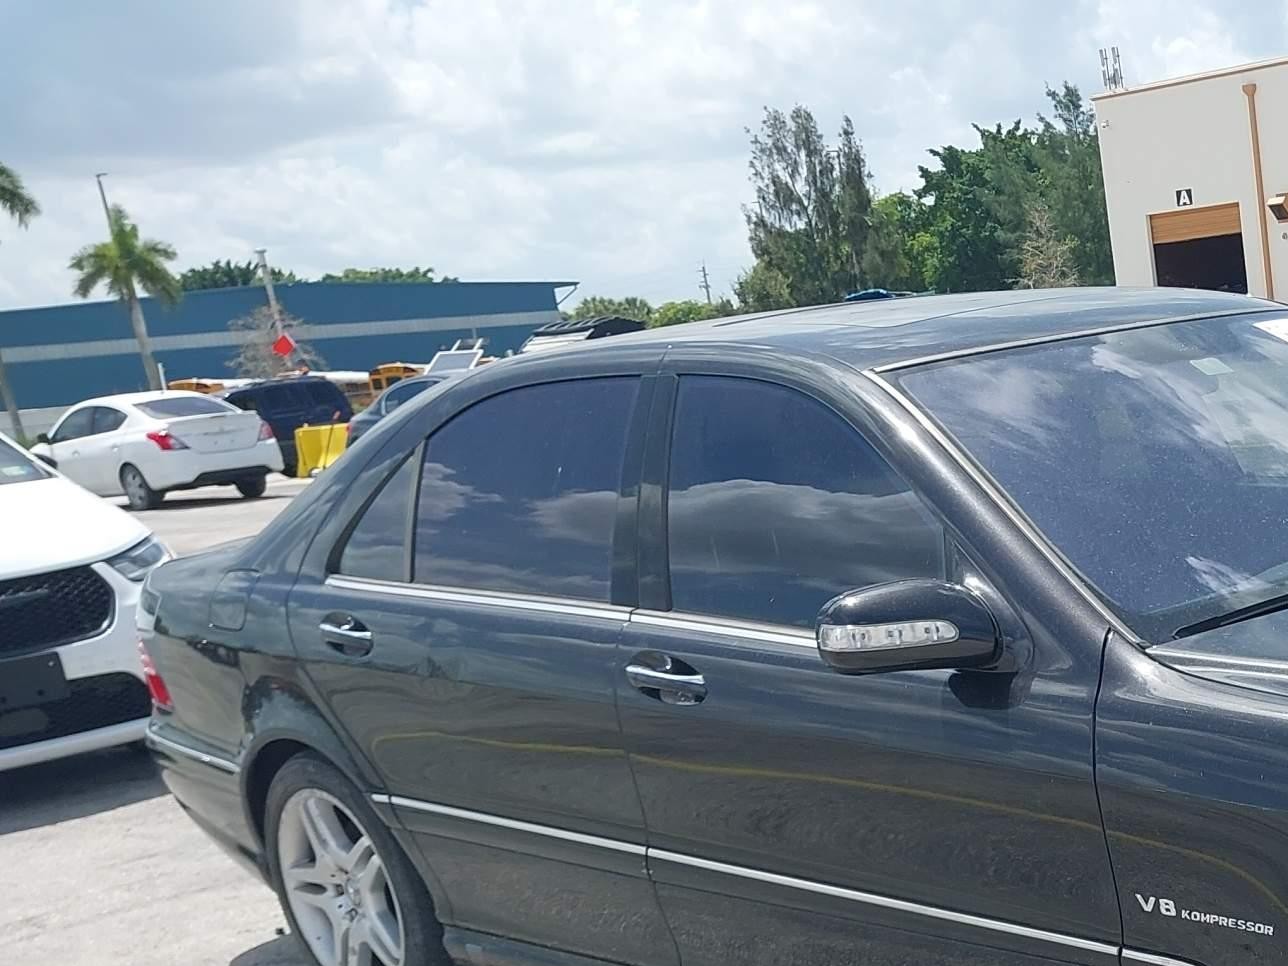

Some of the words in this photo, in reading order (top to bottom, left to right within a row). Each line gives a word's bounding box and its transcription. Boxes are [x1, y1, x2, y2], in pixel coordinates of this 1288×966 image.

[1178, 190, 1191, 206] A
[1134, 893, 1177, 917] V8
[1181, 909, 1275, 936] KOMPRESSOR
